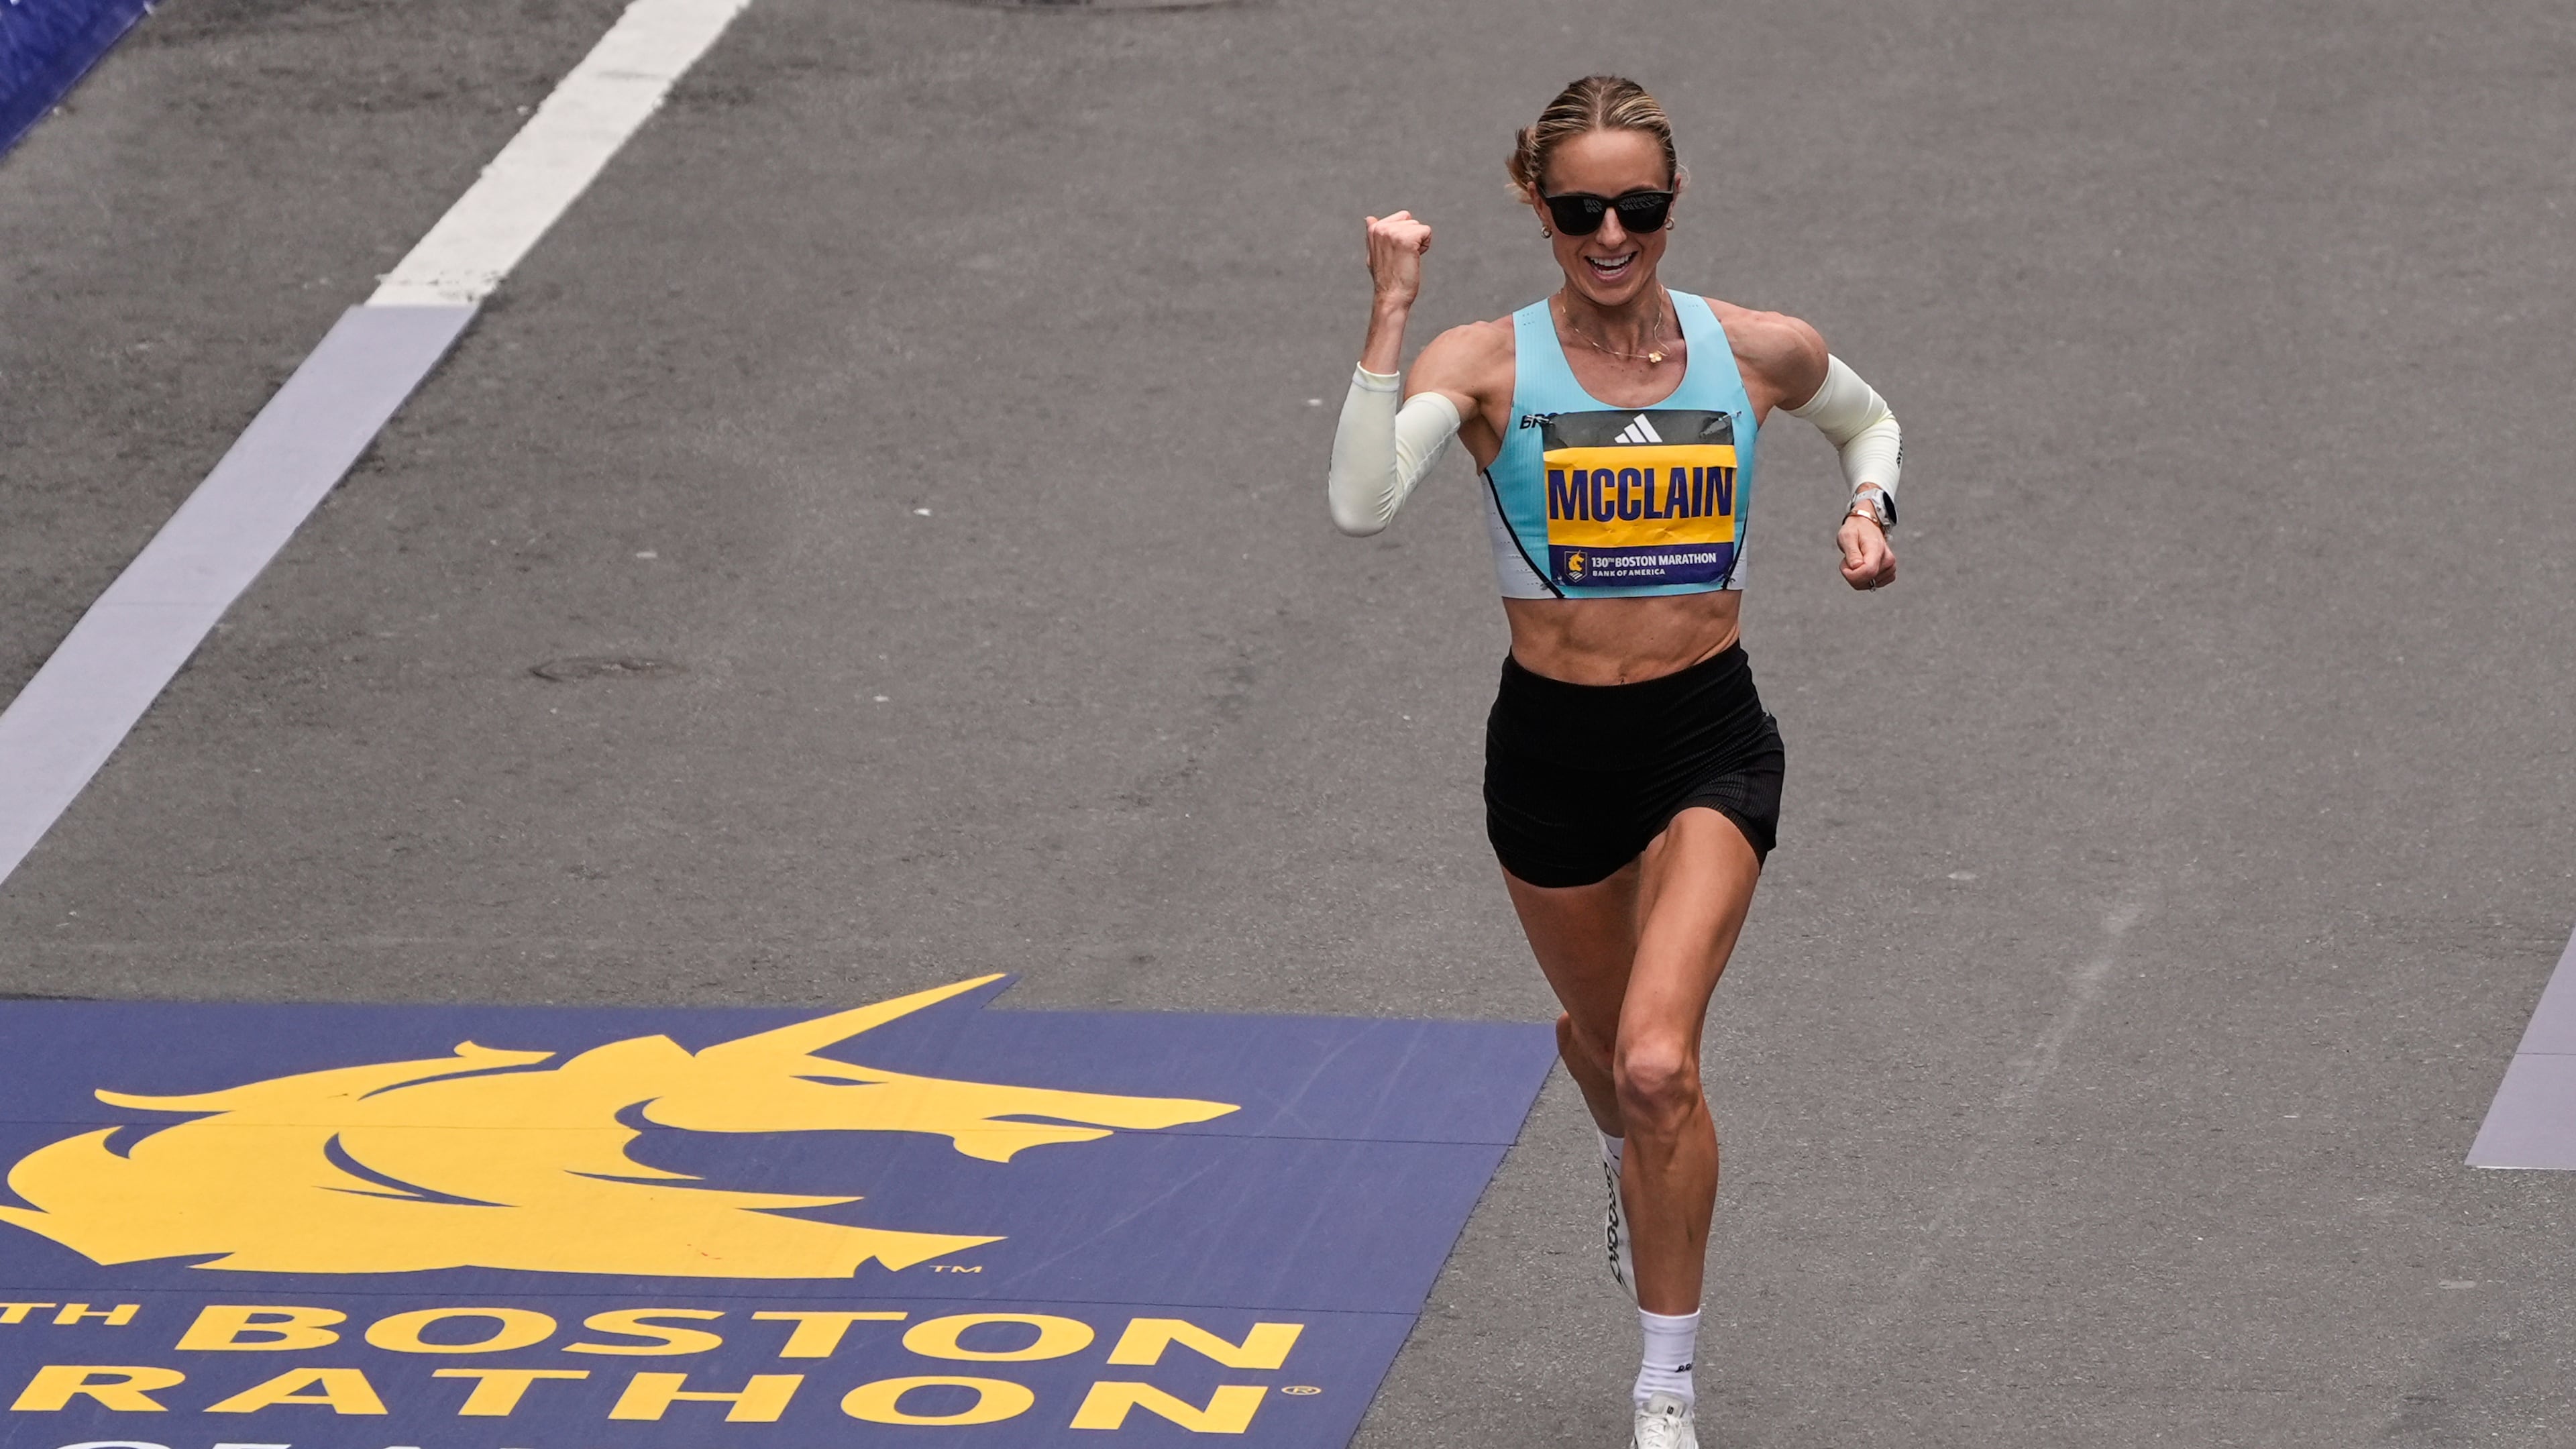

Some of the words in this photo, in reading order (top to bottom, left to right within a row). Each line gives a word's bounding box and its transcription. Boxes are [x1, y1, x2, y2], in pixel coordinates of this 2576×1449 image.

[1548, 467, 1733, 522] MCCLAIN
[1615, 555, 1656, 568] BOSTON
[1658, 553, 1717, 566] MARATHON
[174, 1305, 1304, 1369] BOSTON
